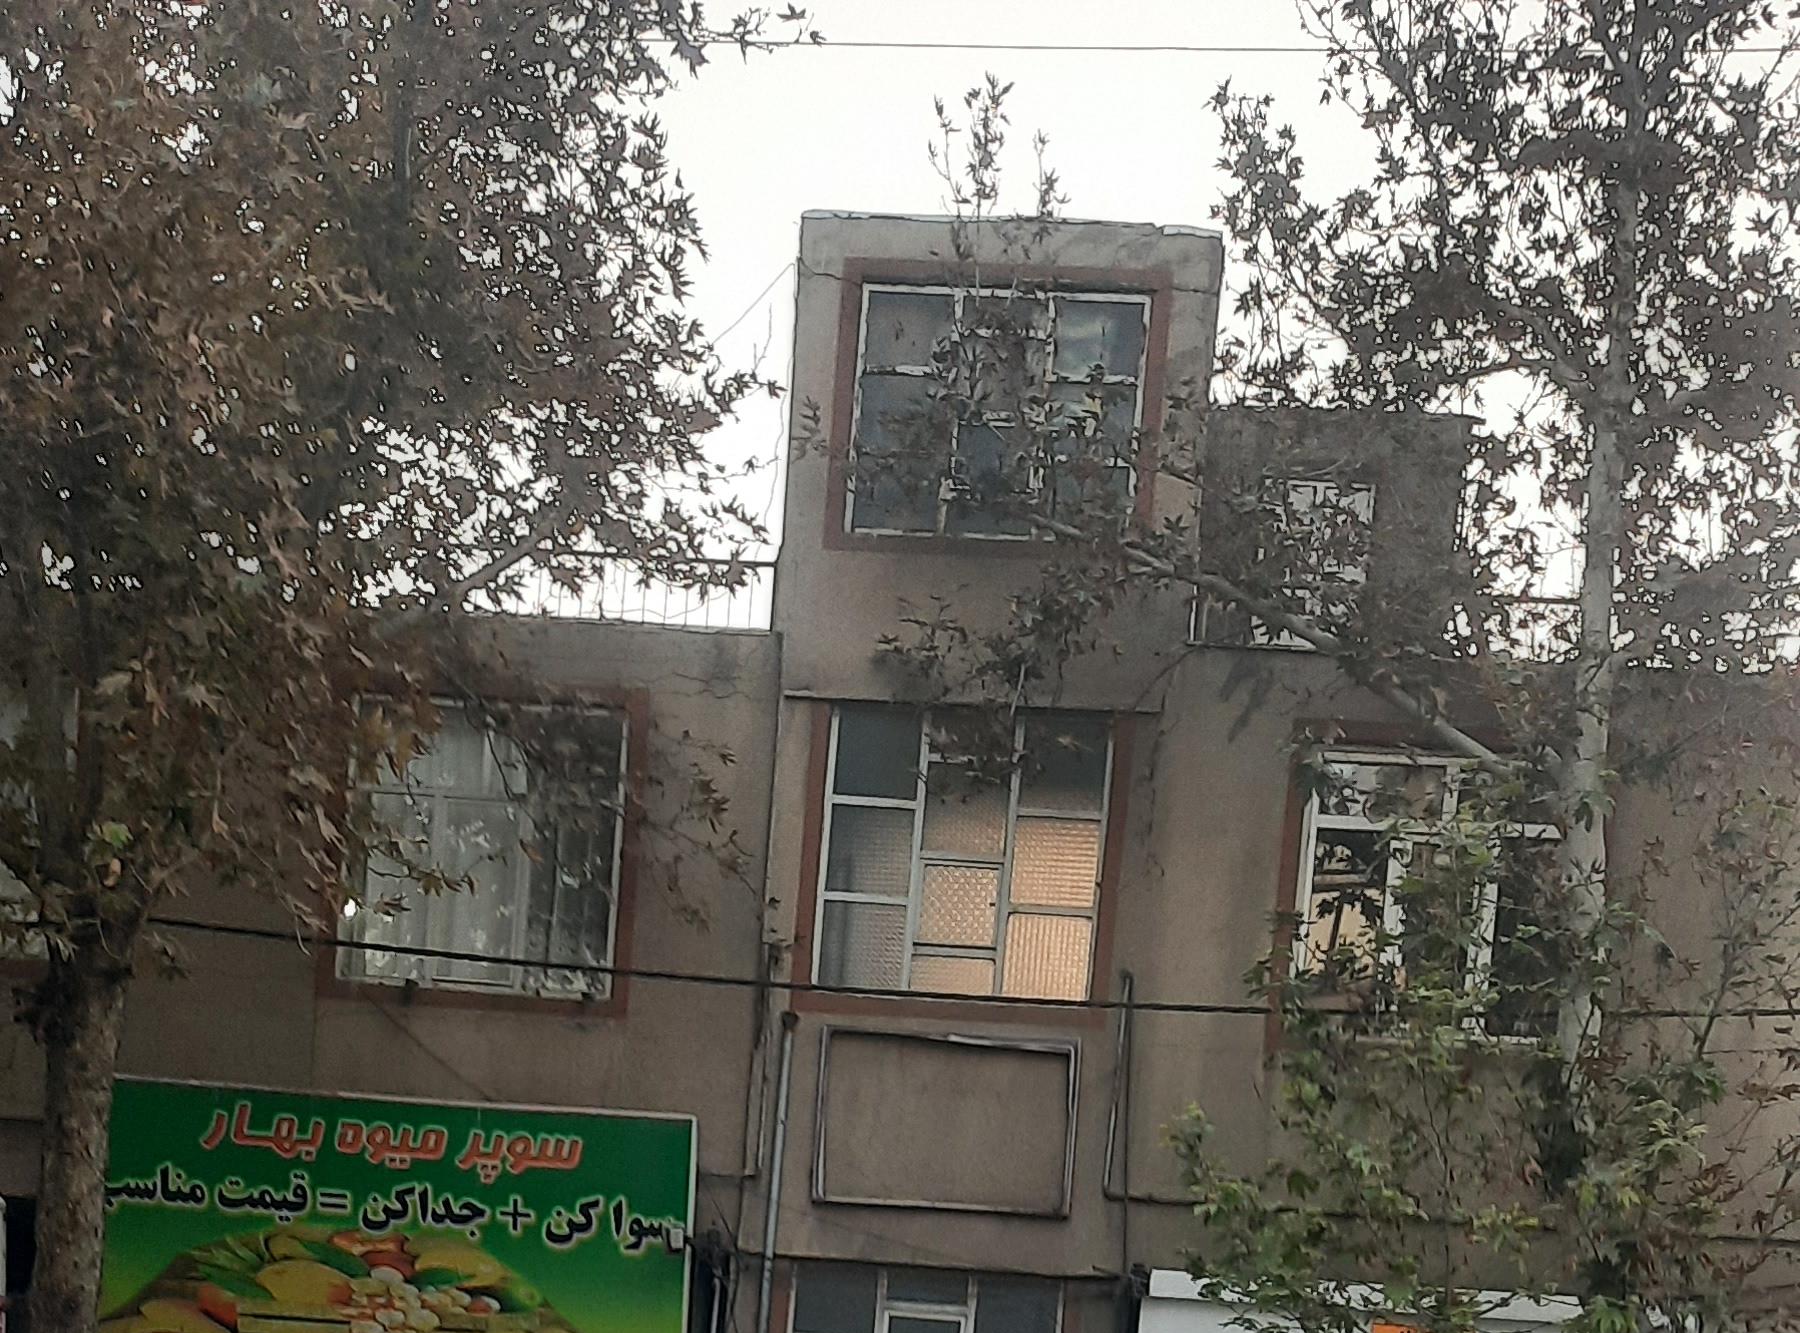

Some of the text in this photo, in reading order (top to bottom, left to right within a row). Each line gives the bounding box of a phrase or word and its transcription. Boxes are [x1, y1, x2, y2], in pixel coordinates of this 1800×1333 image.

[201, 1102, 584, 1184] سوپر میوه بهار
[102, 1163, 206, 1208] مناسب
[217, 1173, 311, 1222] قیمت
[544, 1197, 600, 1246] کن
